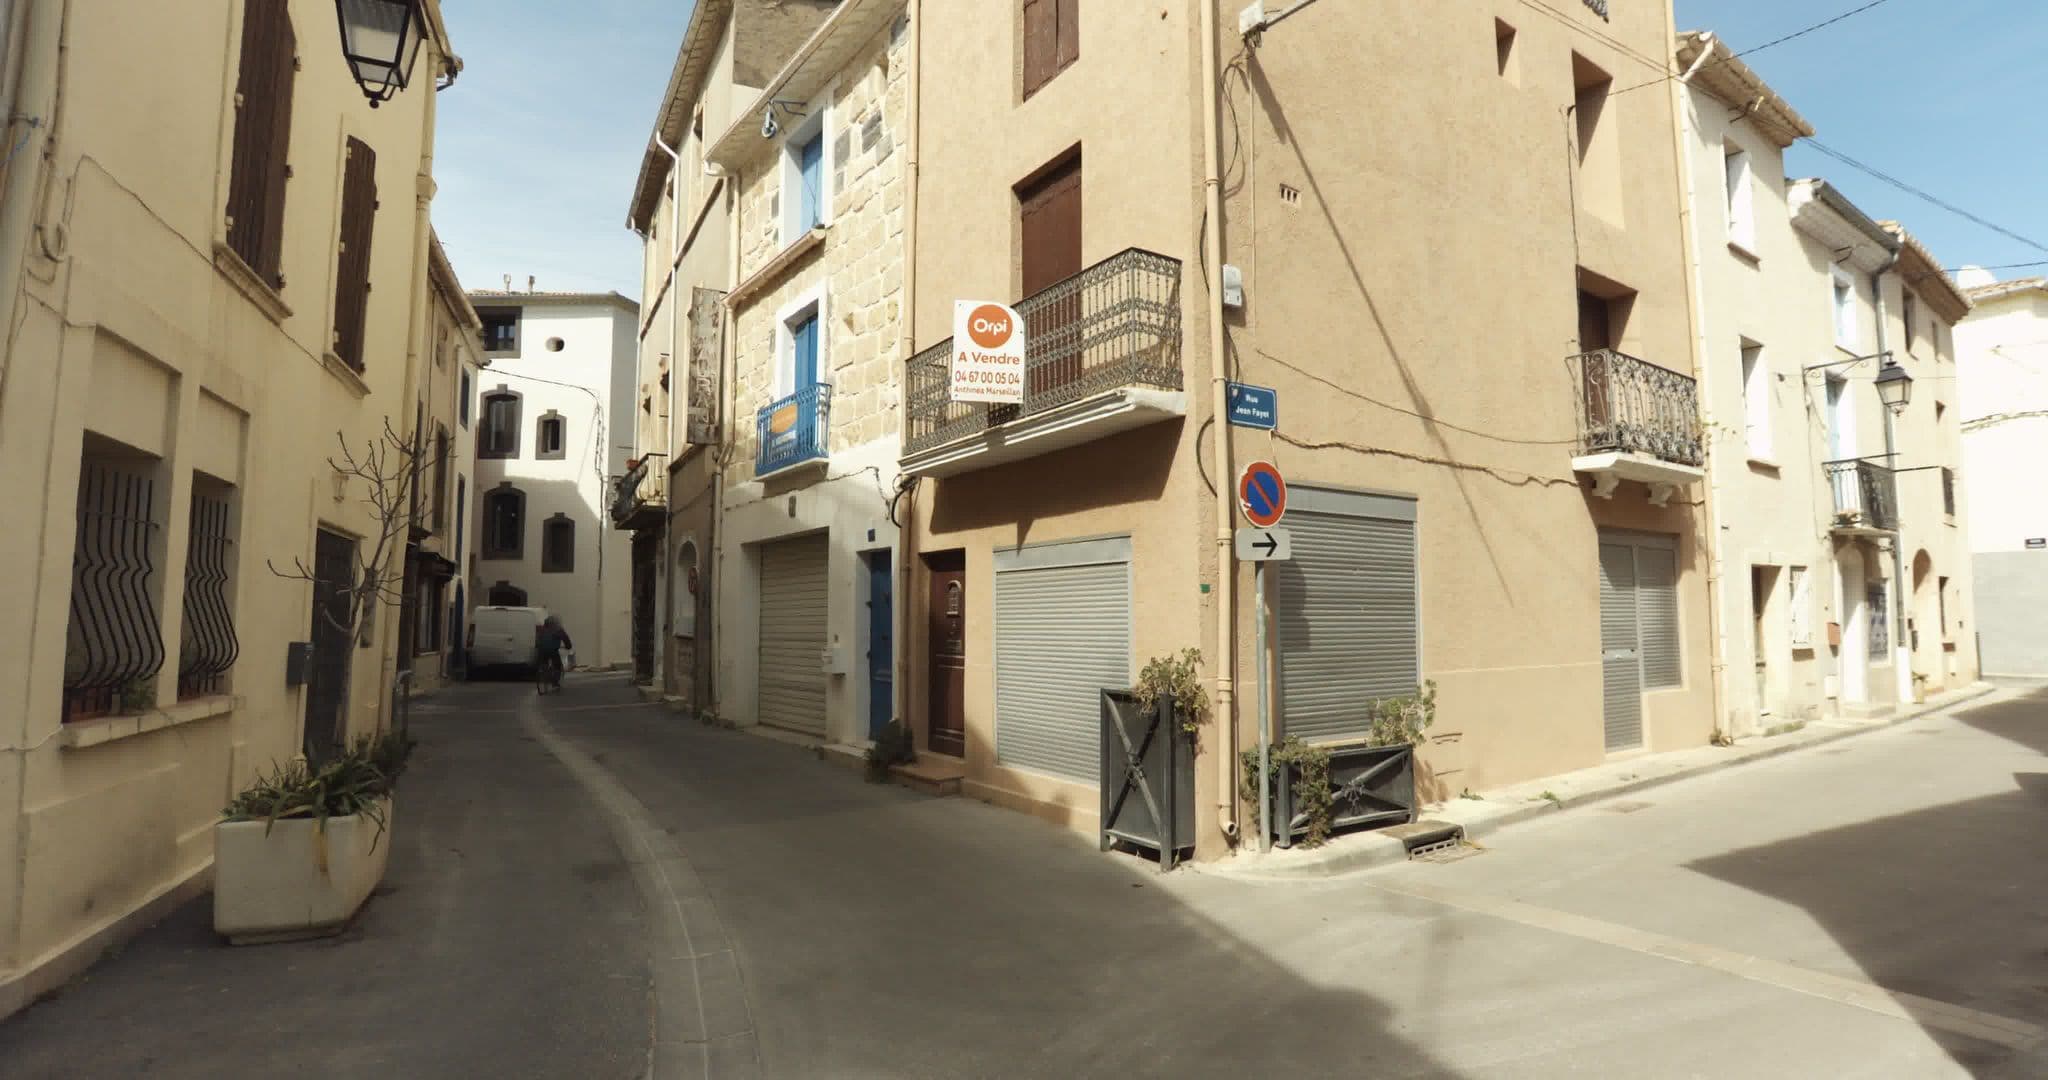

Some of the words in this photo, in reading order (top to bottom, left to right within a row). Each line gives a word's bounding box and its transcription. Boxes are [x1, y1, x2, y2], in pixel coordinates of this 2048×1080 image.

[973, 319, 1007, 336] Orpi
[958, 351, 968, 363] A
[972, 352, 1020, 365] Vendre
[955, 370, 967, 382] 04
[969, 371, 980, 383] 67
[981, 371, 993, 384] 00
[995, 372, 1006, 384] 05
[1008, 373, 1020, 385] 04
[1245, 394, 1258, 403] Rue
[1235, 405, 1251, 415] Jean
